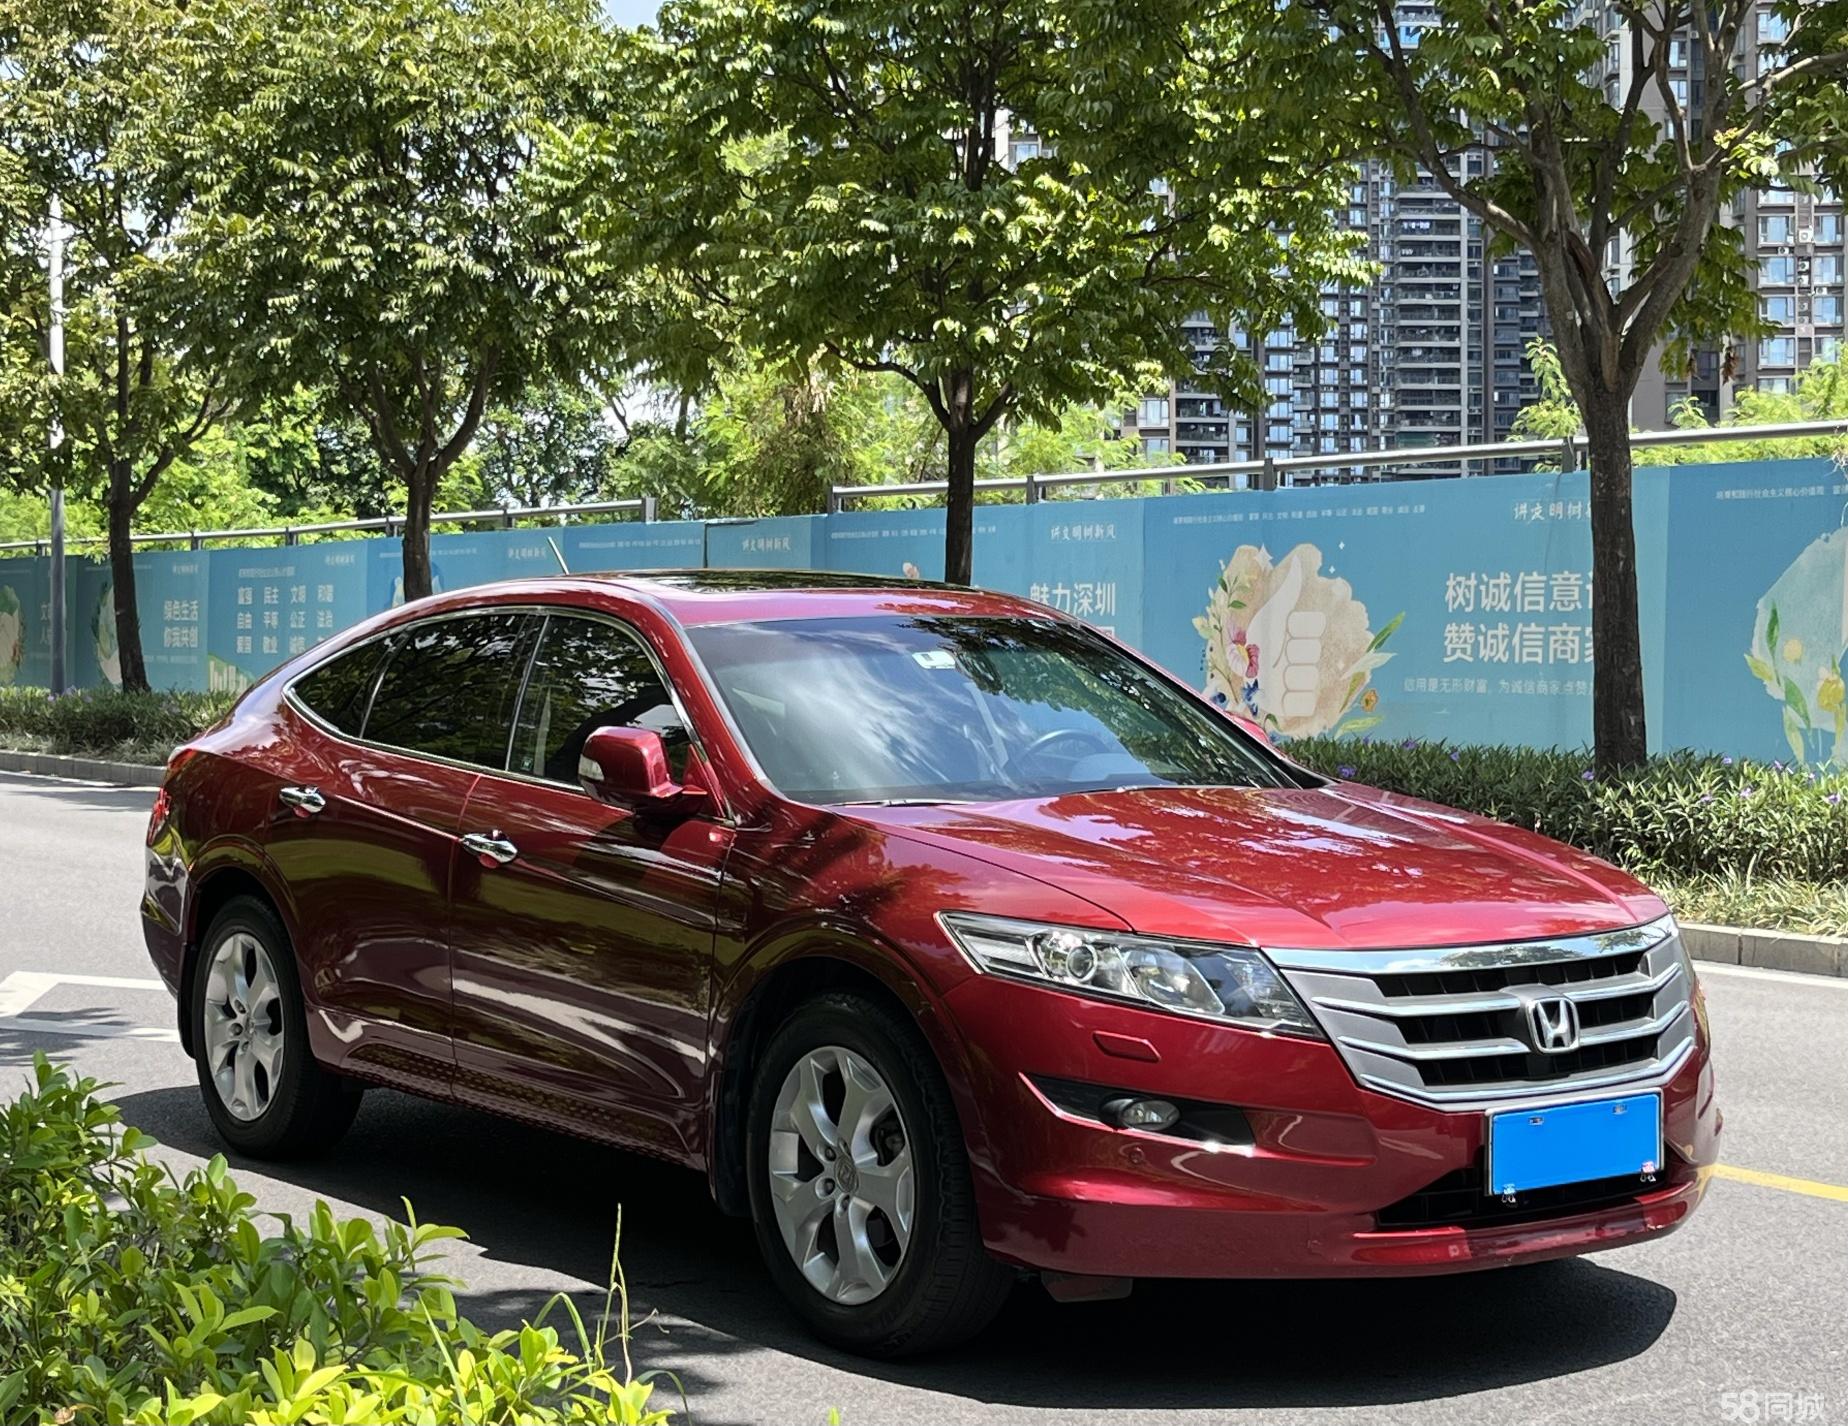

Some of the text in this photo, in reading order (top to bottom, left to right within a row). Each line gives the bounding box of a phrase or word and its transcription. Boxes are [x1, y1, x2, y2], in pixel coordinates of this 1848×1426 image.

[1513, 501, 1592, 523] 讲文明树
[1050, 524, 1116, 540] 讲文明树新风
[1444, 571, 1593, 613] 树诚信意
